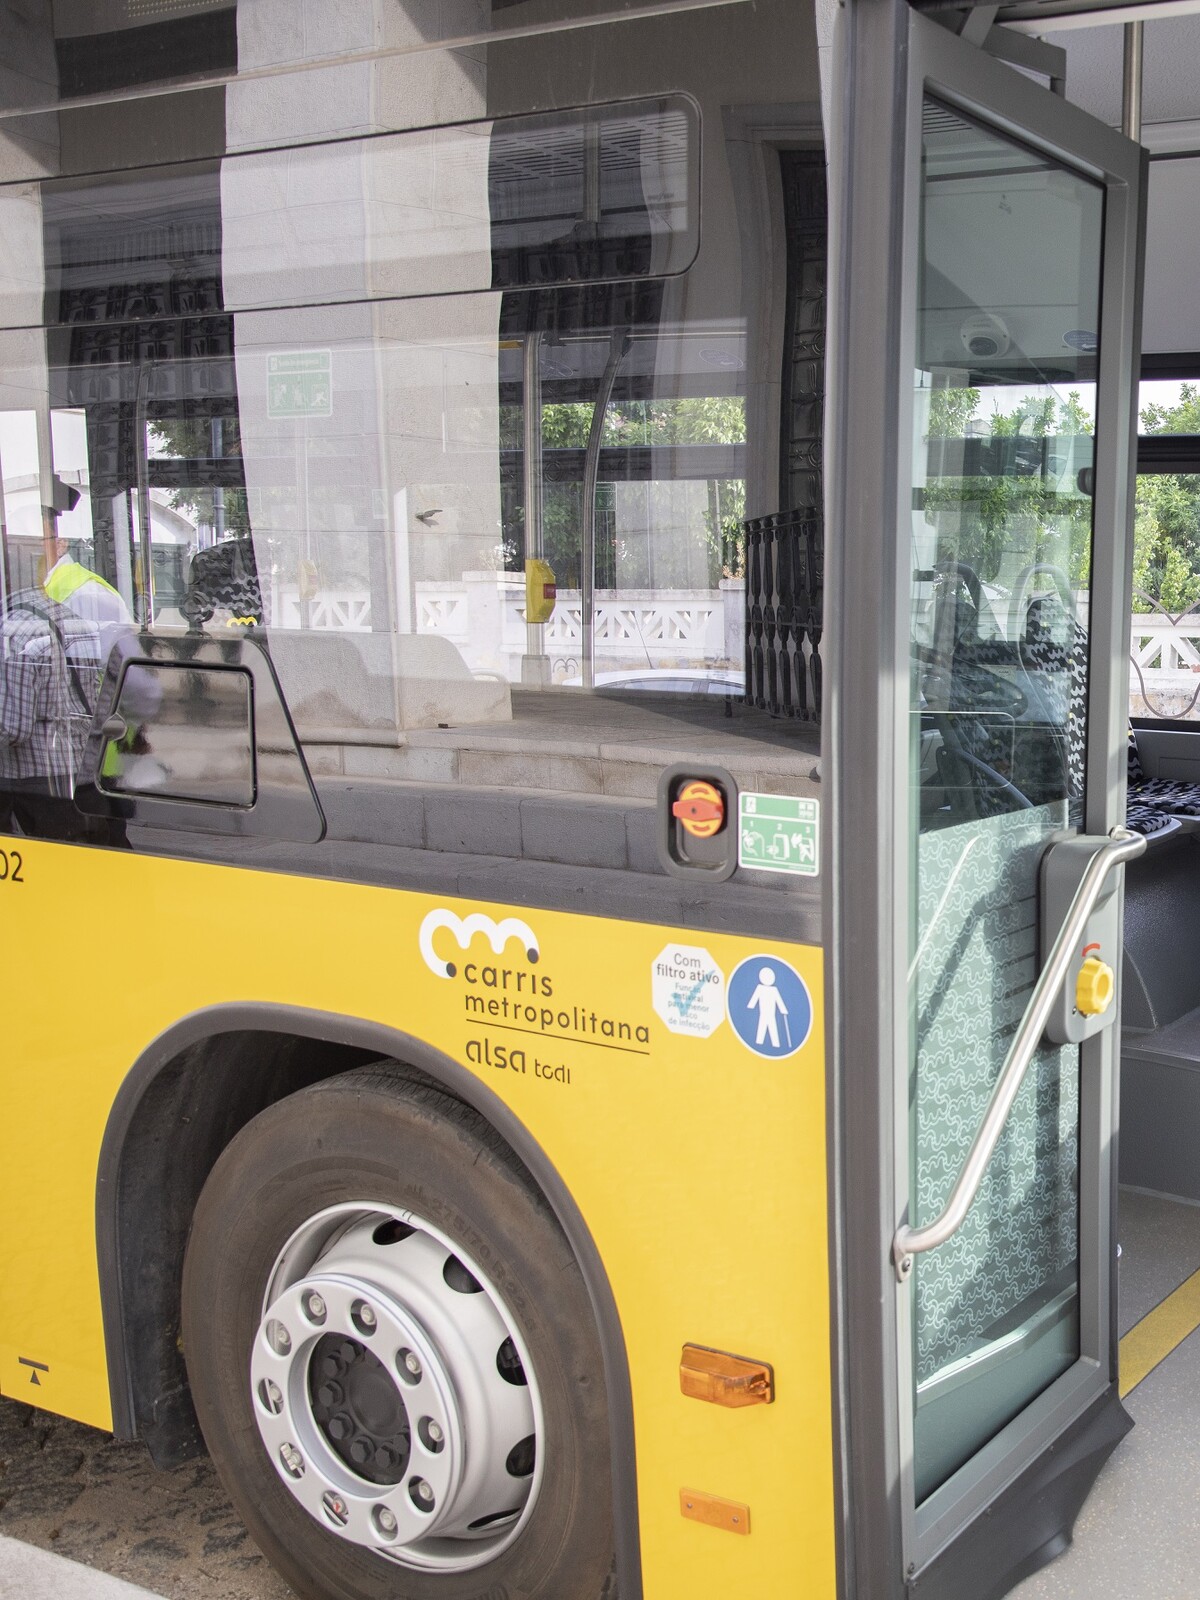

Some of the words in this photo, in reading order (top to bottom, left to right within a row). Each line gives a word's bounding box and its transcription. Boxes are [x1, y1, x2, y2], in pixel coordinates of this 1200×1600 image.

[656, 963, 686, 979] filtro
[690, 970, 720, 984] ativo
[674, 953, 701, 968] Com
[464, 963, 553, 997] carris
[465, 994, 650, 1043] metropolitana
[465, 1038, 526, 1074] alsa
